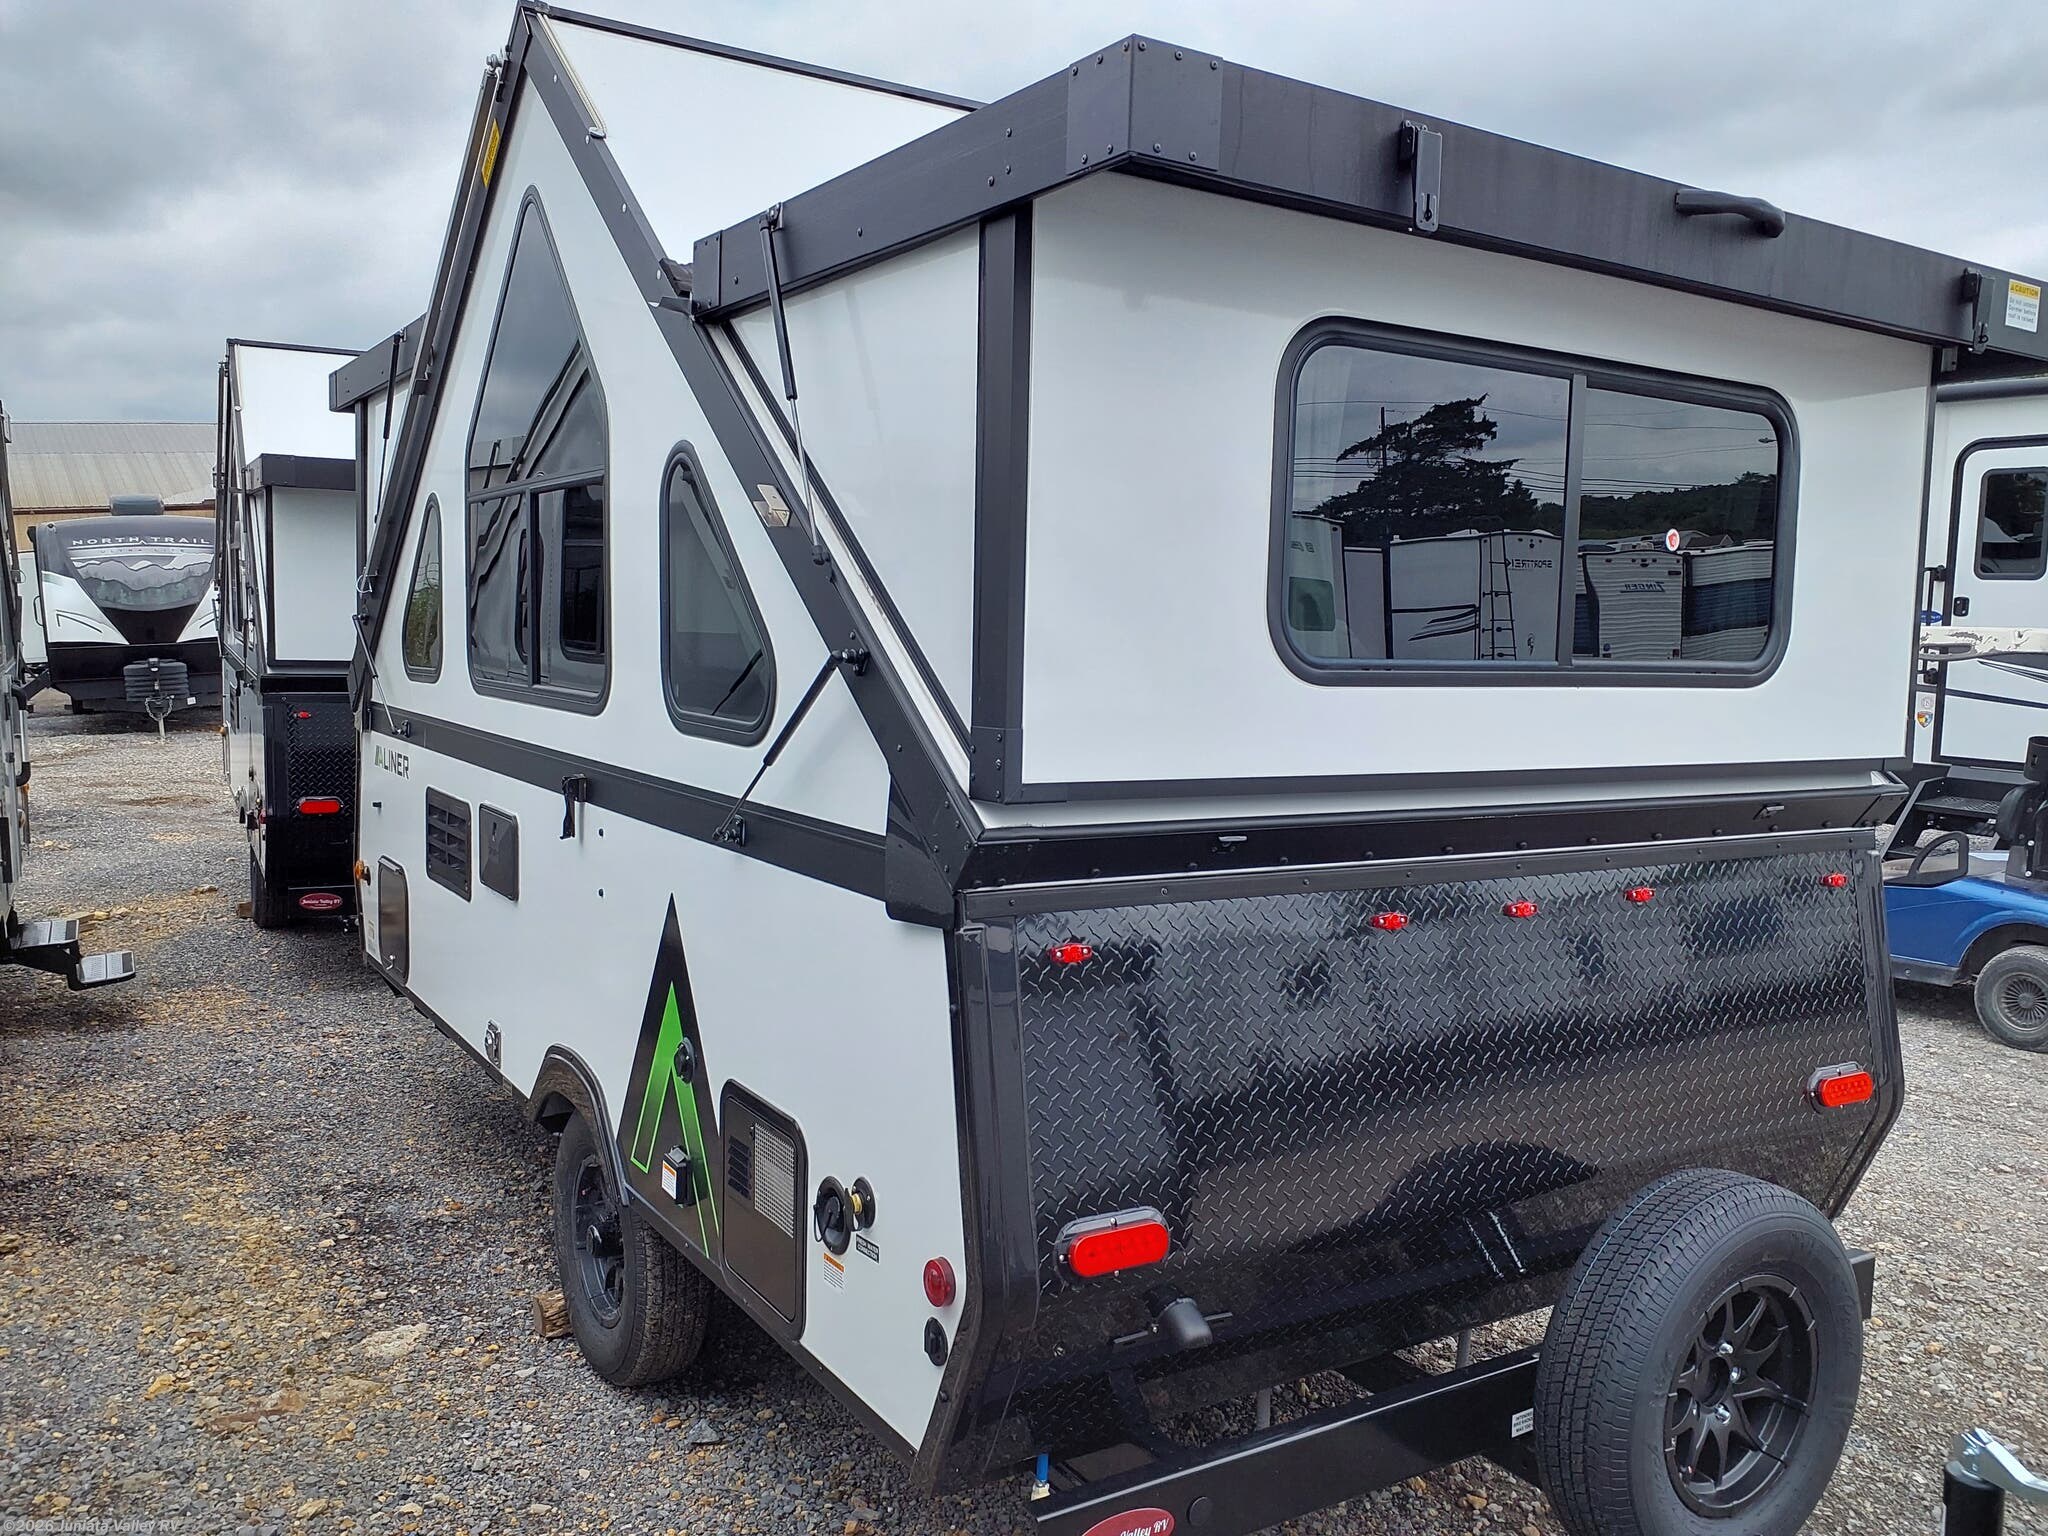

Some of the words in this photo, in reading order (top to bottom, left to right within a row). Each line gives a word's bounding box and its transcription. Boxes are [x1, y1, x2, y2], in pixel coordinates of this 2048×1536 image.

[2014, 284, 2039, 297] CAUTION
[72, 536, 139, 546] NORTH
[150, 536, 210, 544] TRAIL
[375, 745, 409, 779] ALINER
[1153, 1518, 1170, 1534] RV
